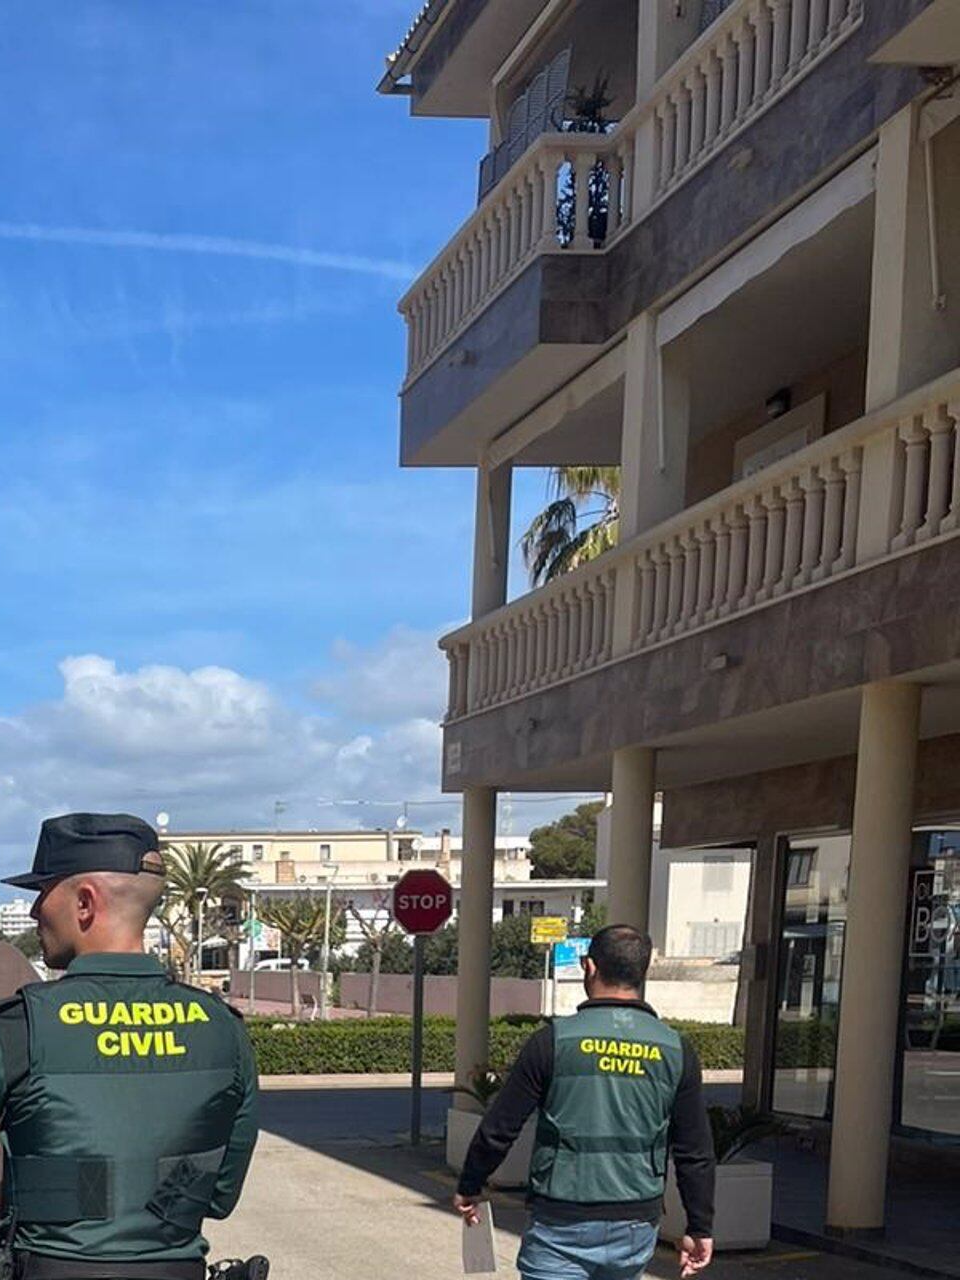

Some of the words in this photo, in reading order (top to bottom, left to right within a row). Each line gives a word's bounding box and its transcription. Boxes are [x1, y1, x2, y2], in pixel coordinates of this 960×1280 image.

[399, 894, 447, 910] STOP
[59, 1002, 210, 1025] GUARDIA
[97, 1031, 186, 1056] CIVIL
[580, 1039, 662, 1061] GUARDIA
[599, 1057, 645, 1075] CIVIL
